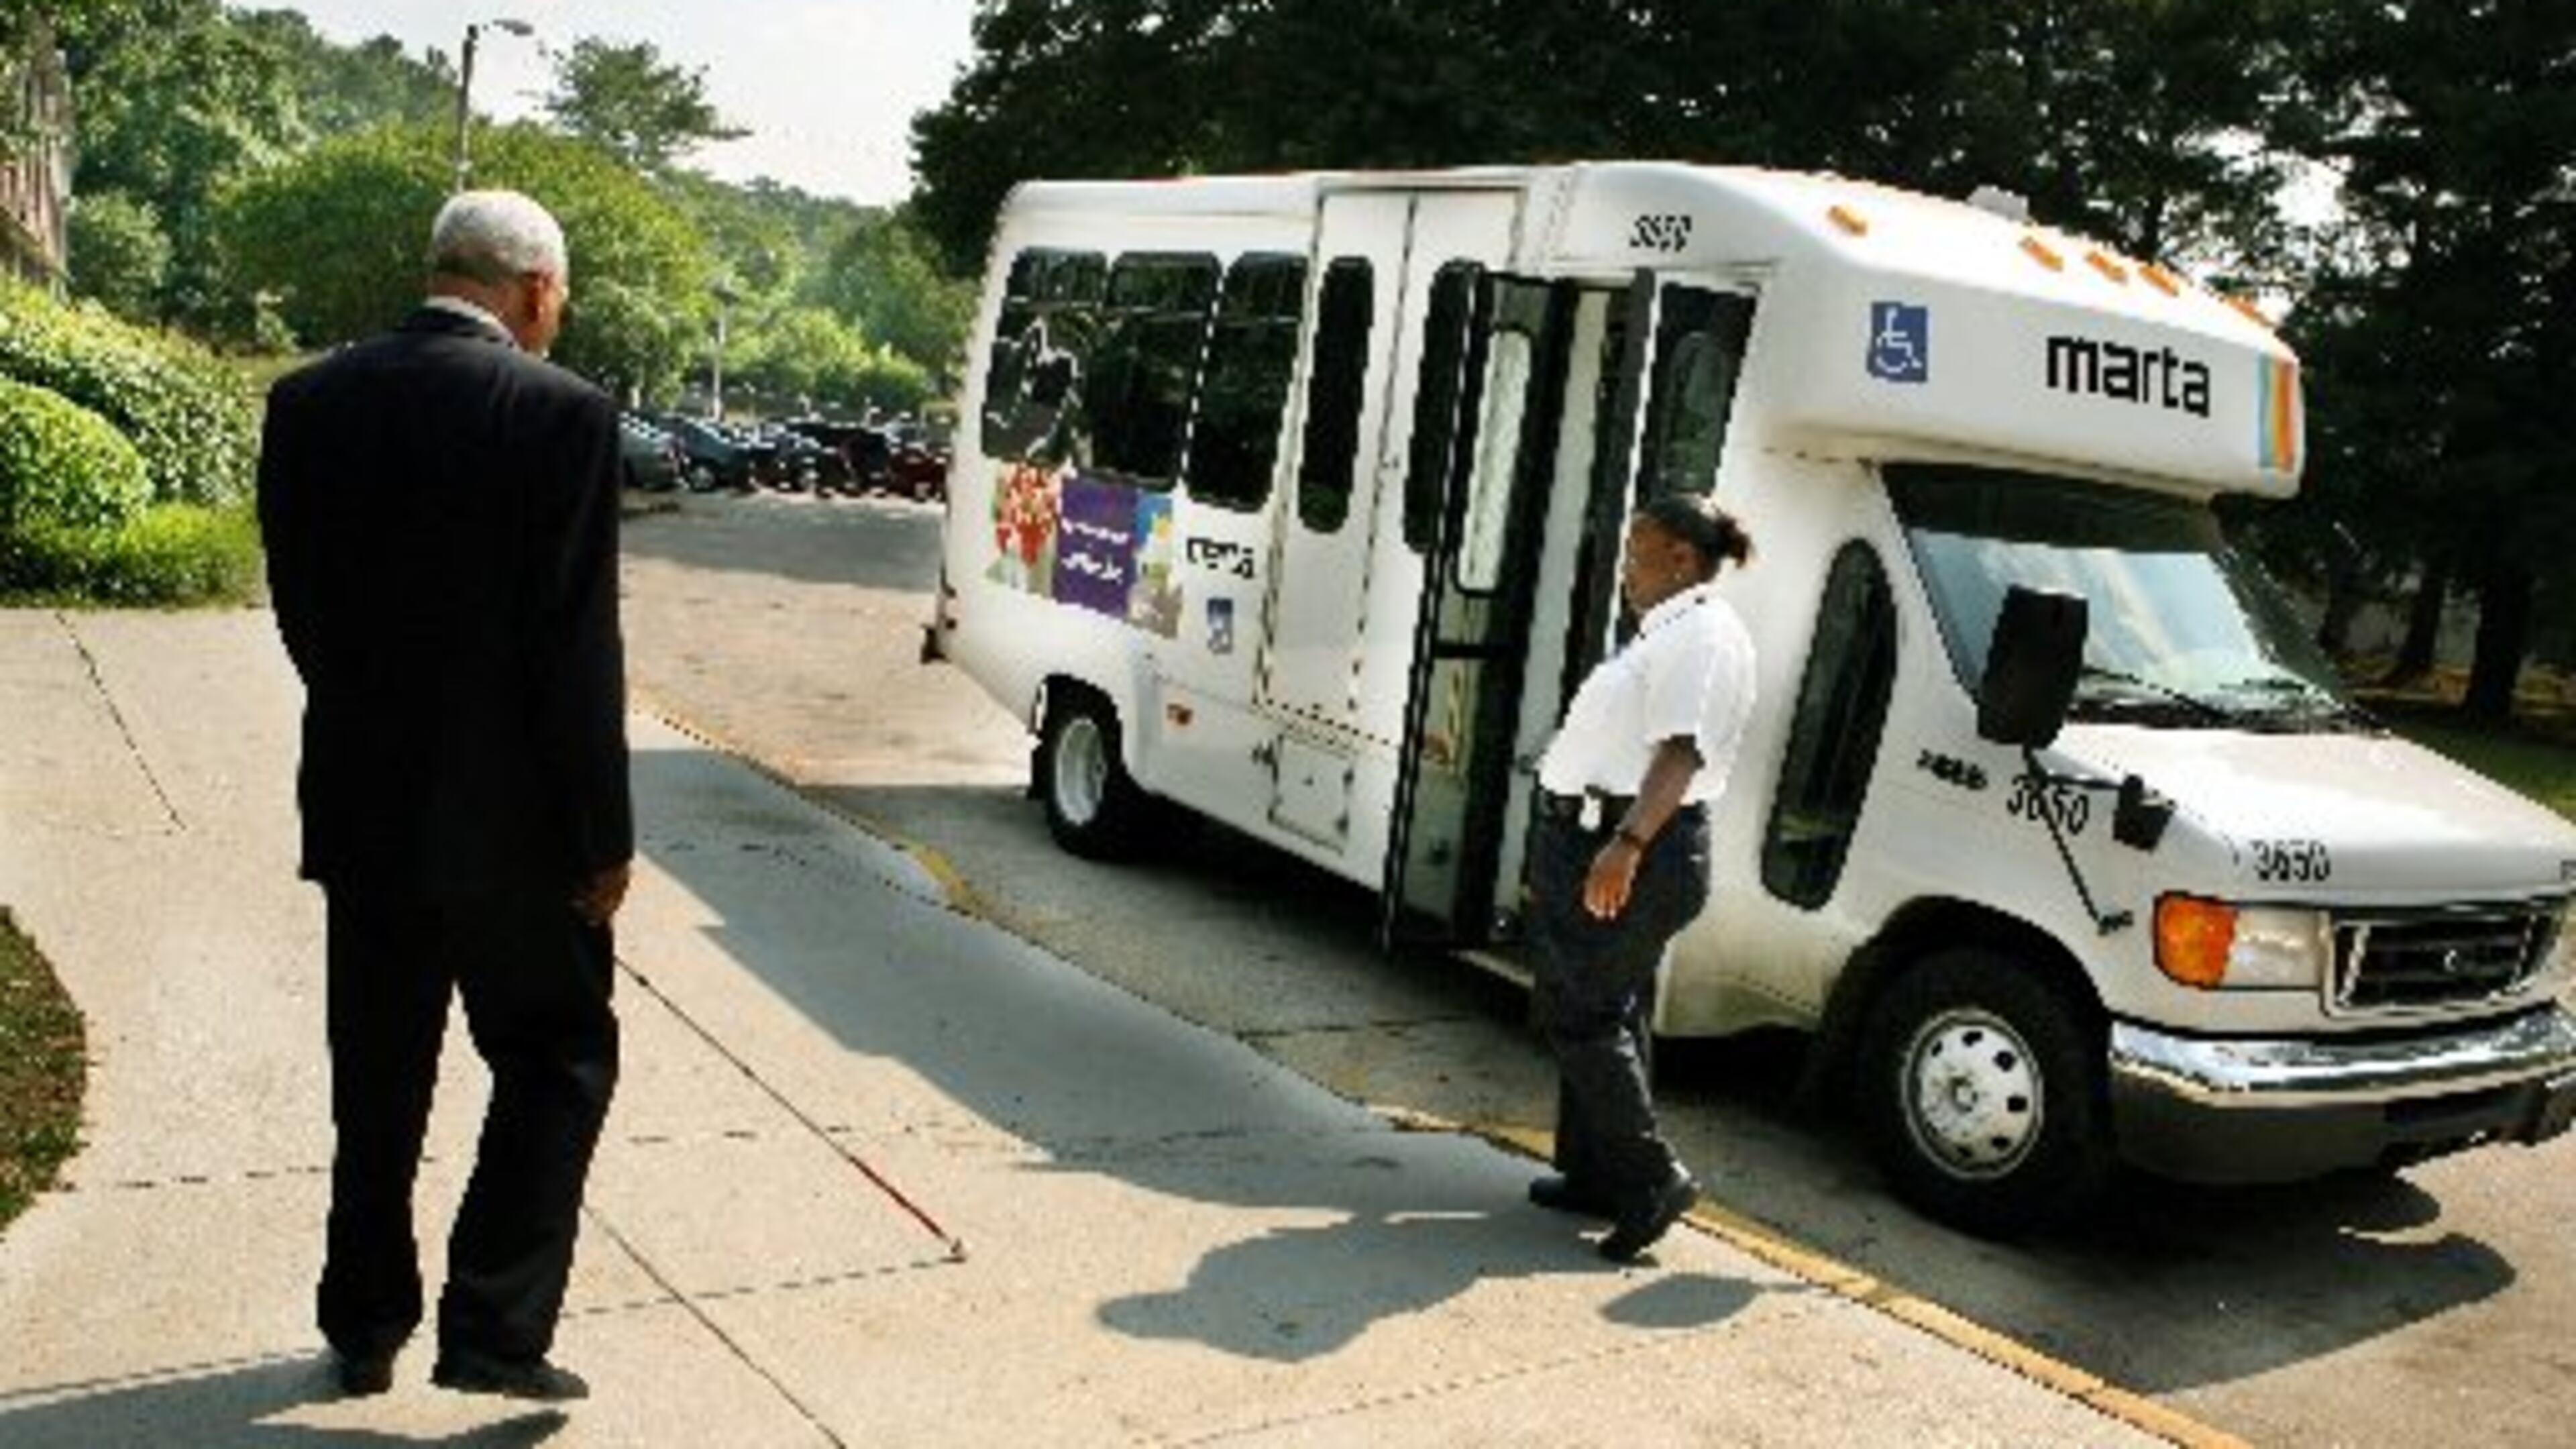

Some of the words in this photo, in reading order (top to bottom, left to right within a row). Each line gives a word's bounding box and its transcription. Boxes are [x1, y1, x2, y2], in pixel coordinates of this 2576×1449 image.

[2047, 336, 2209, 418] marta
[2006, 773, 2089, 836] 3650
[2249, 839, 2330, 881] 3650
